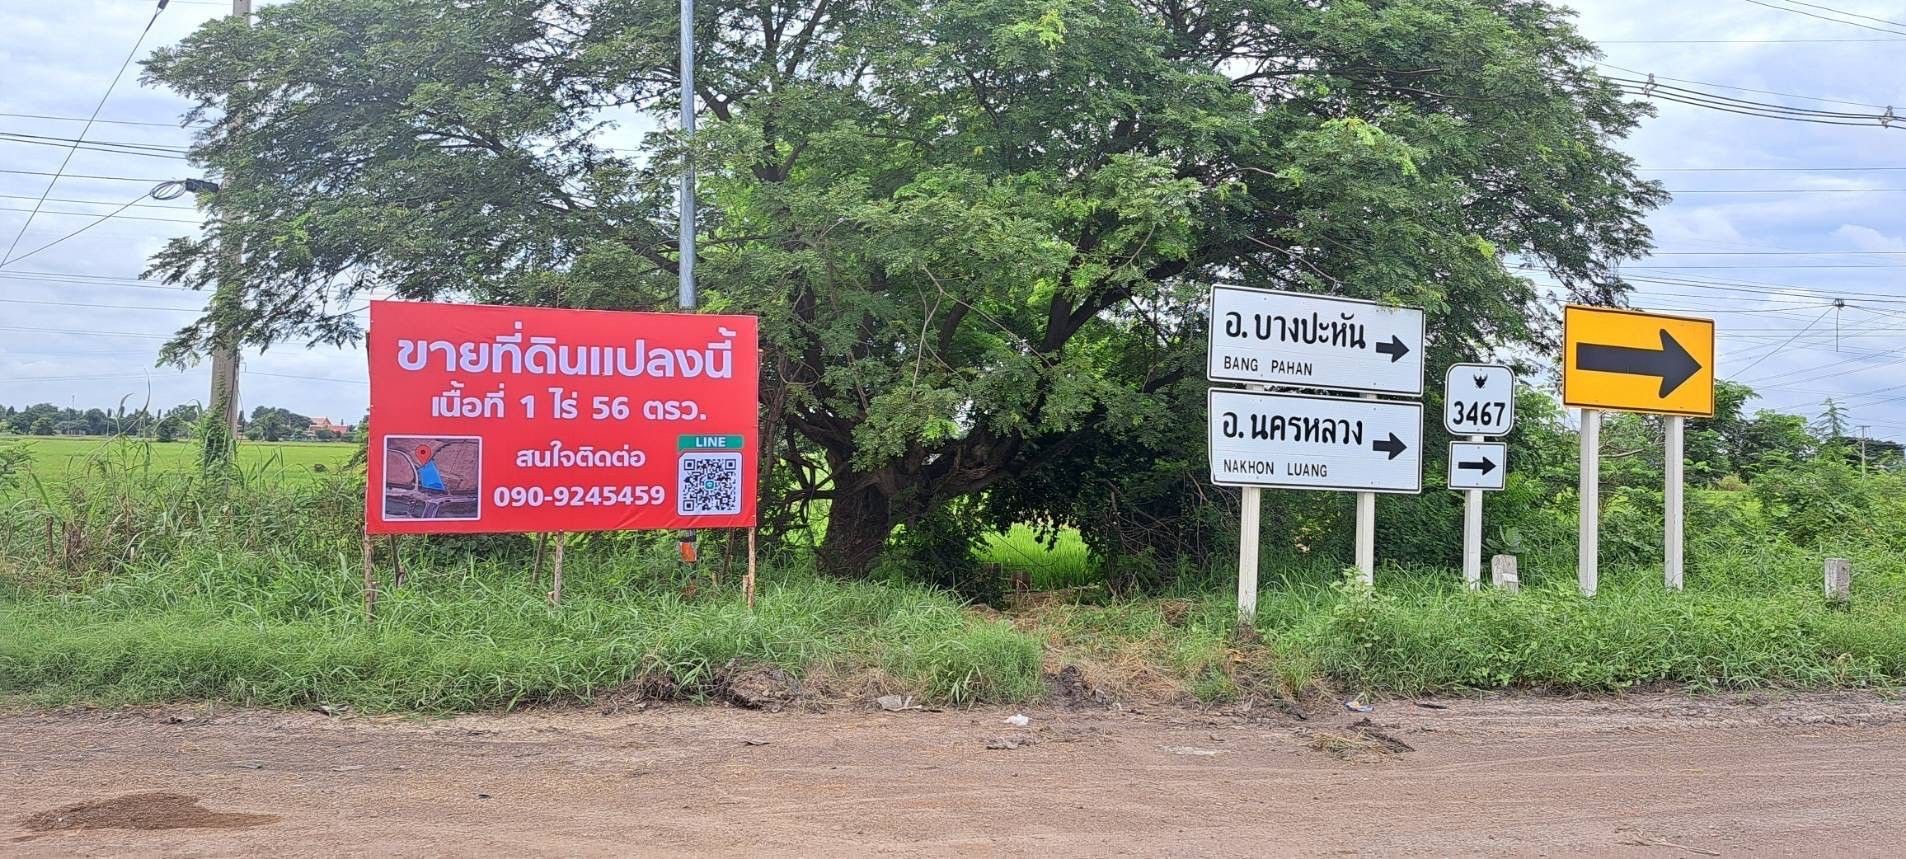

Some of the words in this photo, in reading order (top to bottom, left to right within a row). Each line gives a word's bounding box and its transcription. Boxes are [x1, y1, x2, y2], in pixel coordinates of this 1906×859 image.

[397, 322, 736, 378] ขายที่ดินแปลงนี้
[1224, 356, 1258, 372] BANG
[1272, 361, 1313, 376] PAHAN
[431, 381, 504, 418] เนื้อที่
[520, 396, 536, 418] 1
[549, 388, 579, 420] ไร่
[593, 396, 630, 420] 56
[643, 400, 707, 420] ตรว.
[1453, 401, 1506, 427] 3467
[516, 441, 646, 468] สนใจติดต่อ
[695, 437, 727, 448] LINE
[1224, 459, 1274, 475] NAKHON
[1287, 462, 1328, 478] LUANG
[494, 486, 666, 508] 090-9245459
